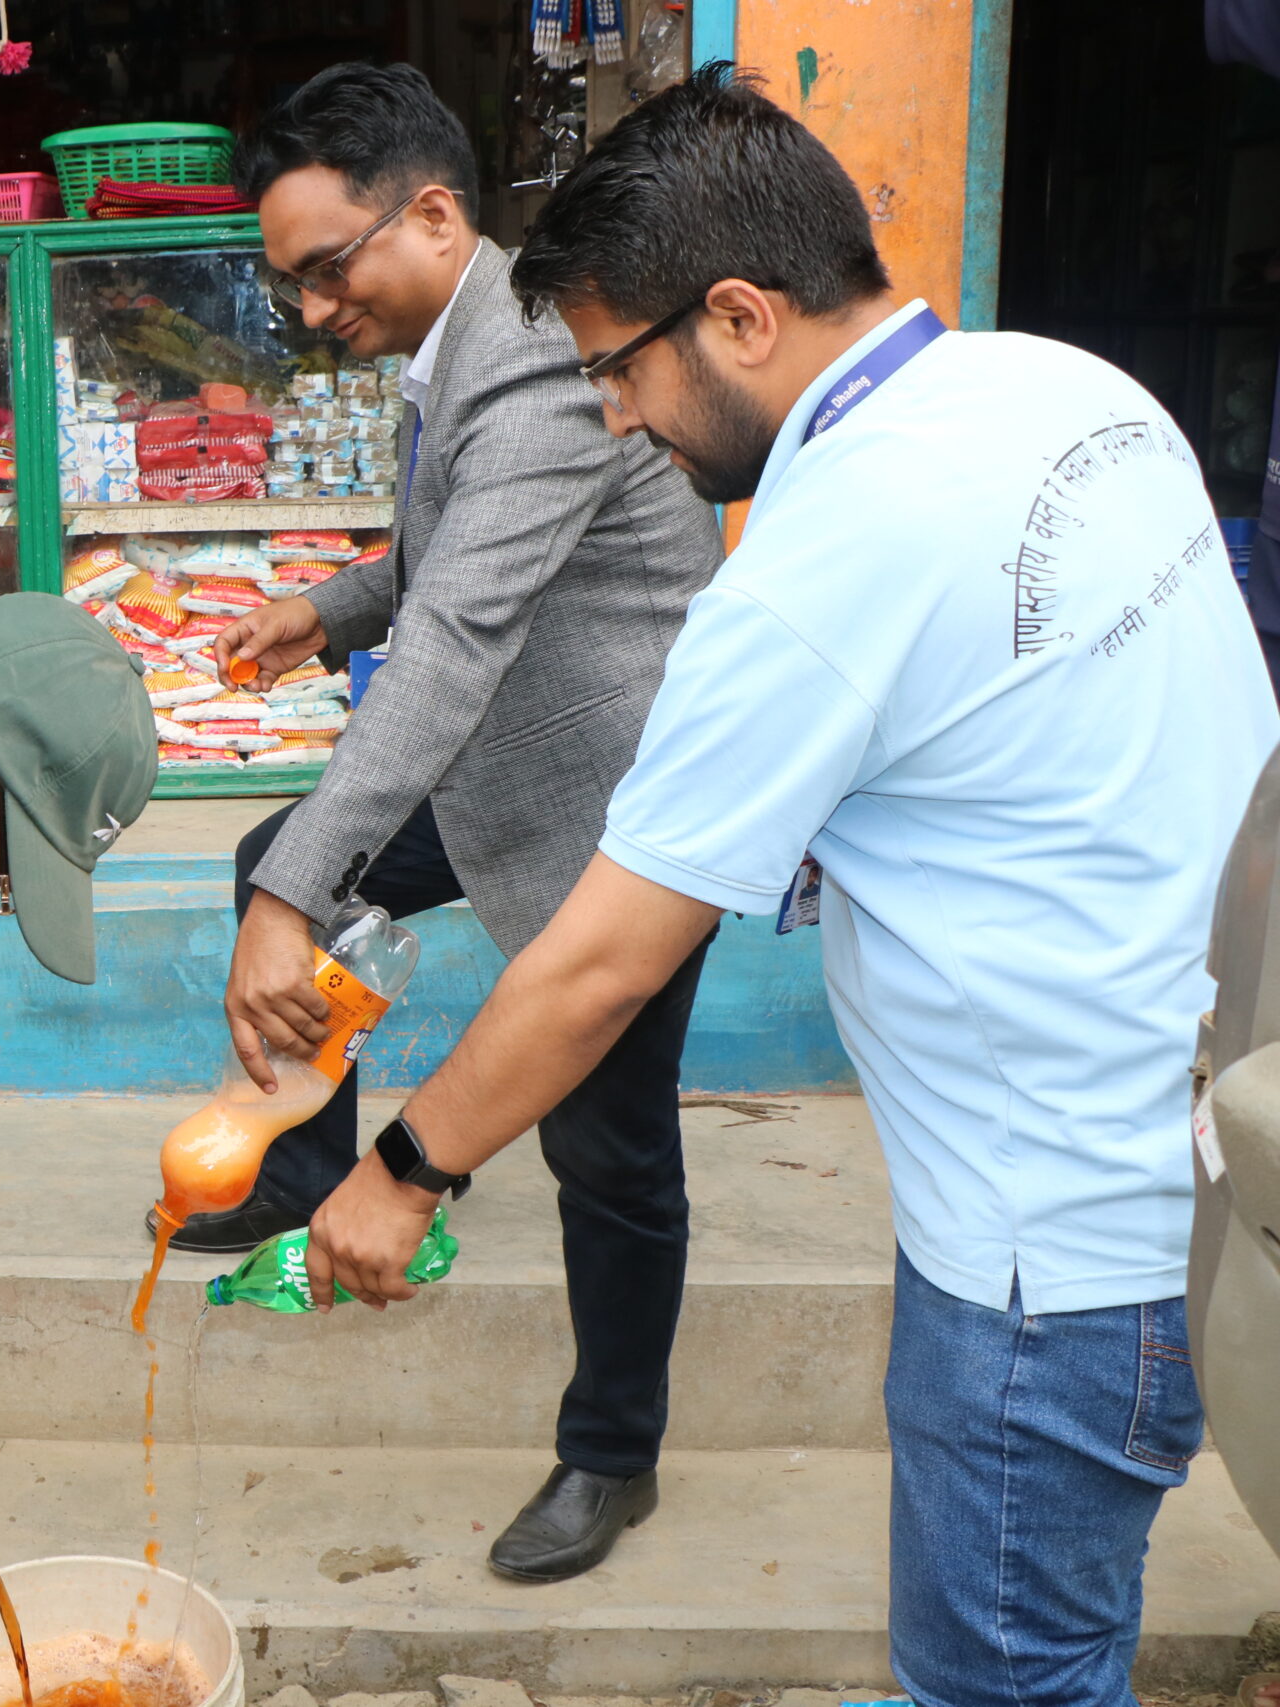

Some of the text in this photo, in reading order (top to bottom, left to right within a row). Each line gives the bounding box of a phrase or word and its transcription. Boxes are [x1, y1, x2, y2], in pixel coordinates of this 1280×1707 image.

[830, 375, 872, 409] Dhading
[1025, 494, 1084, 540] वस्तु
[1001, 542, 1074, 659] गुणस्तरीय
[283, 1245, 317, 1311] rite
